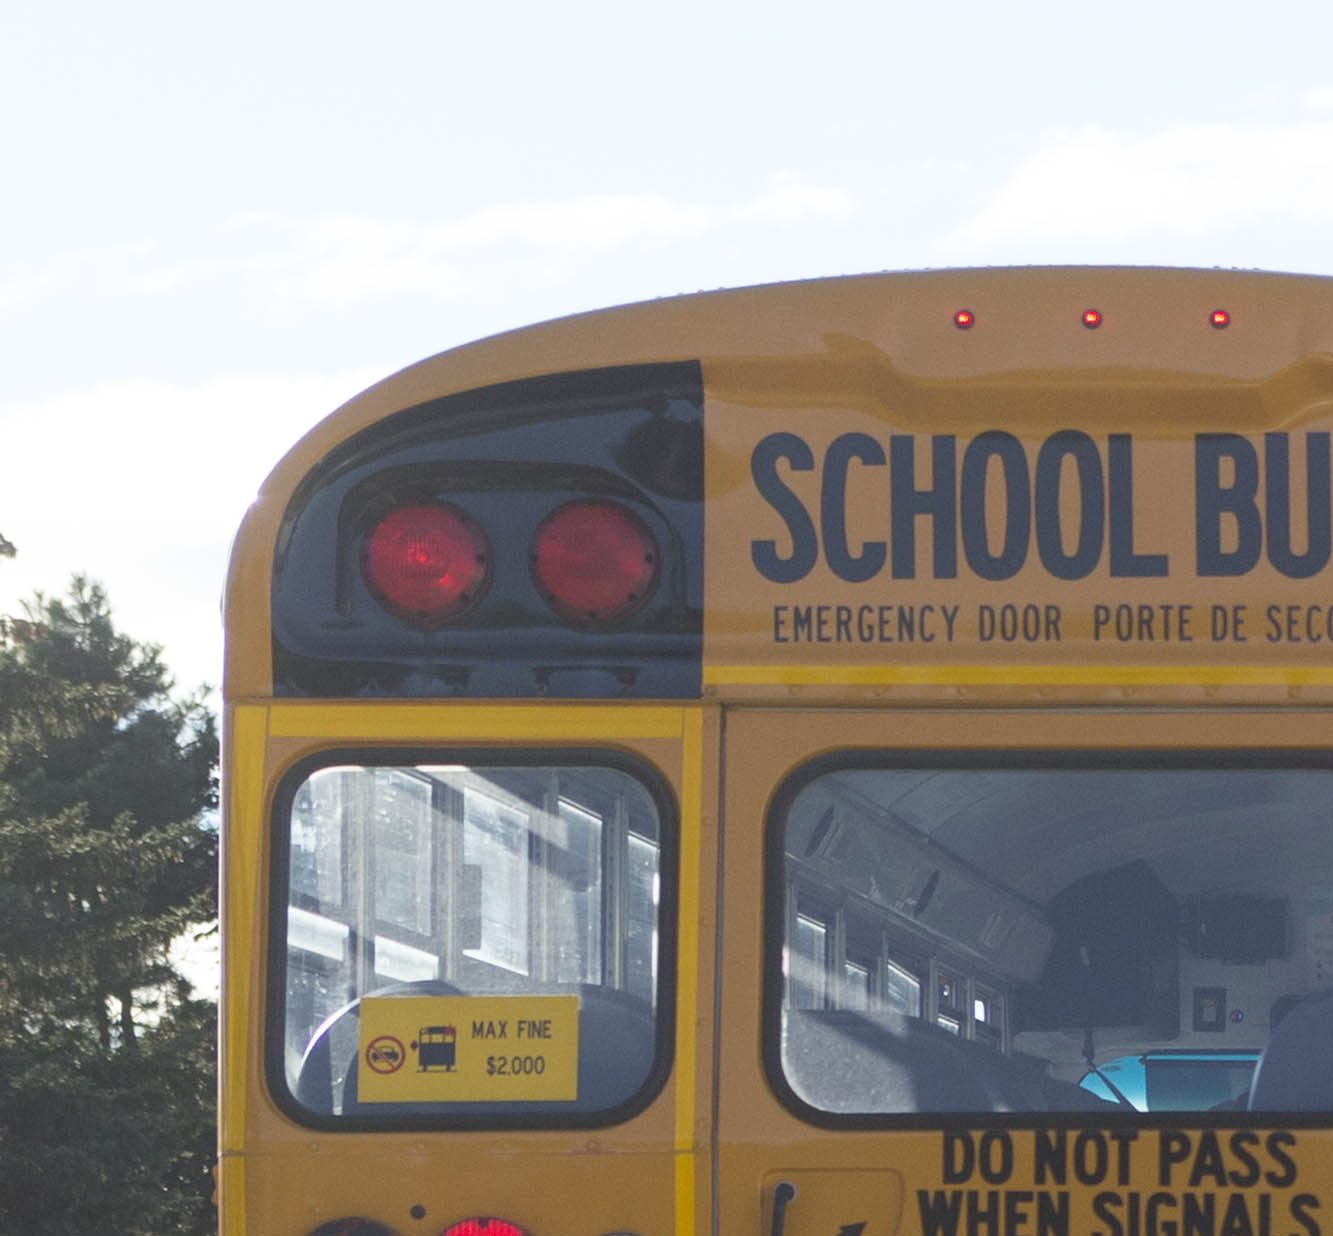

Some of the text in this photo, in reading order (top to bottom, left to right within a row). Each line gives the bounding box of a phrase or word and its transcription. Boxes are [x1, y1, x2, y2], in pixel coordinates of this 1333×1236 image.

[750, 428, 1168, 584] SCHOOL
[774, 605, 959, 643] EMERGENCY
[978, 604, 1062, 643] DOOR
[1093, 604, 1193, 642] PORTE
[1211, 604, 1248, 642] DE
[471, 1020, 552, 1039] MAX FINE
[942, 1130, 1298, 1188] DO NOT PASS
